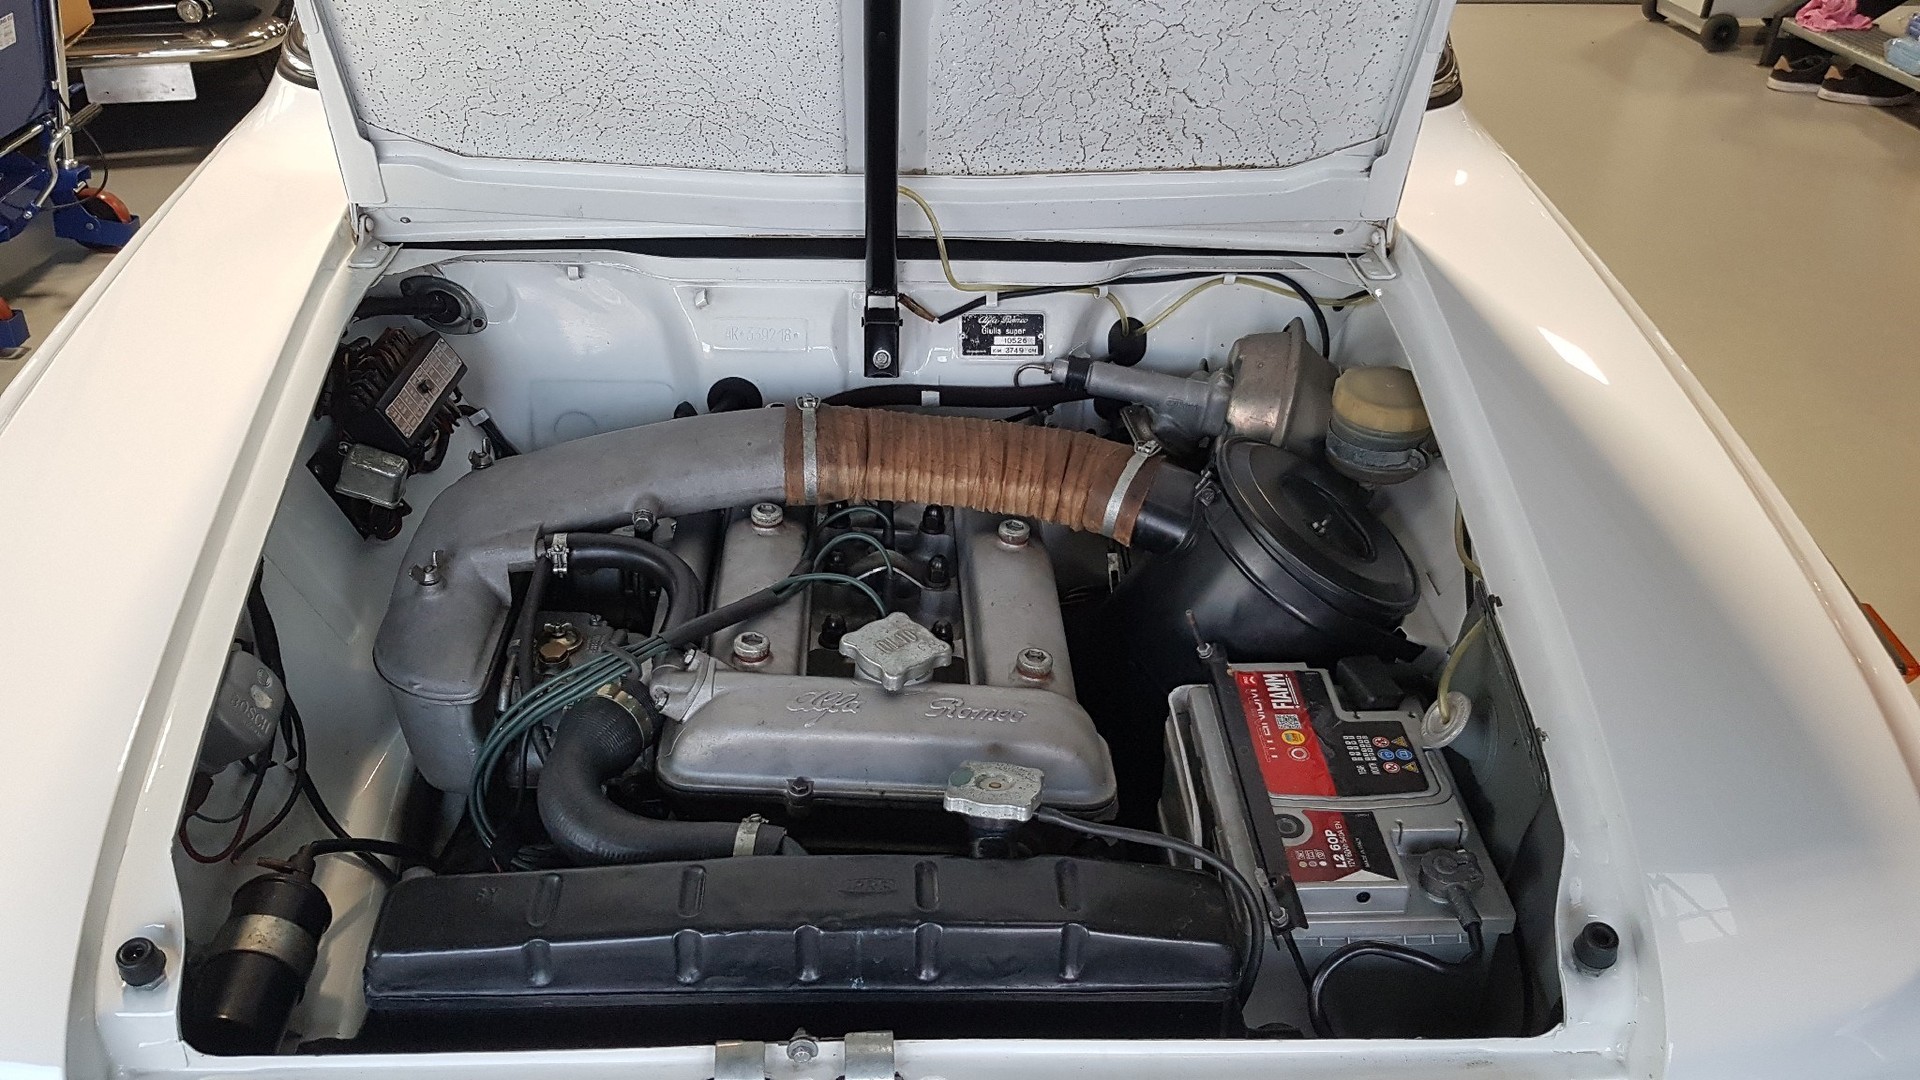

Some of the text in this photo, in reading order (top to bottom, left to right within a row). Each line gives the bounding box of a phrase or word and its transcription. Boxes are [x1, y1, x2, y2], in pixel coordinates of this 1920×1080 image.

[981, 327, 1002, 335] Giulia
[786, 690, 1028, 728] Alfa Romeo
[1262, 673, 1295, 710] FIAMM
[230, 694, 272, 735] BOSCH
[1334, 820, 1343, 830] EN
[1324, 829, 1348, 868] L2 60P
